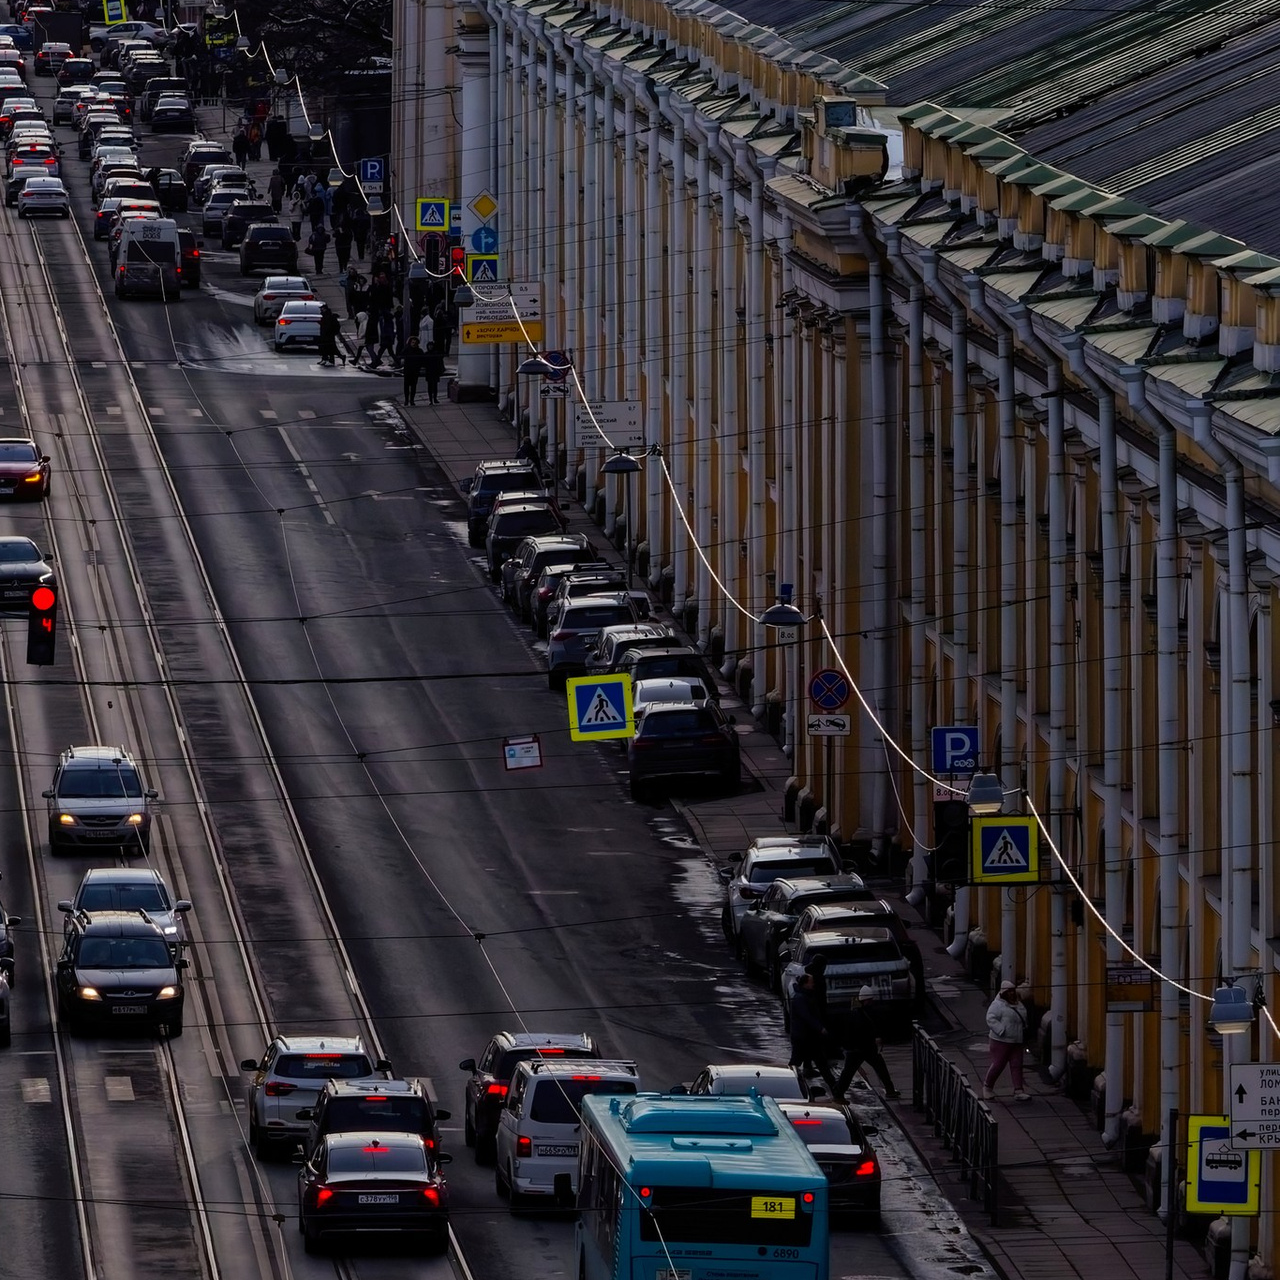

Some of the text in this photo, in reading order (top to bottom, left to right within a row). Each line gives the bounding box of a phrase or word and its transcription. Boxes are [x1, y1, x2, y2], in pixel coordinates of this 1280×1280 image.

[42, 617, 52, 633] 4
[762, 1201, 784, 1213] 181
[773, 1248, 799, 1259] 6890
